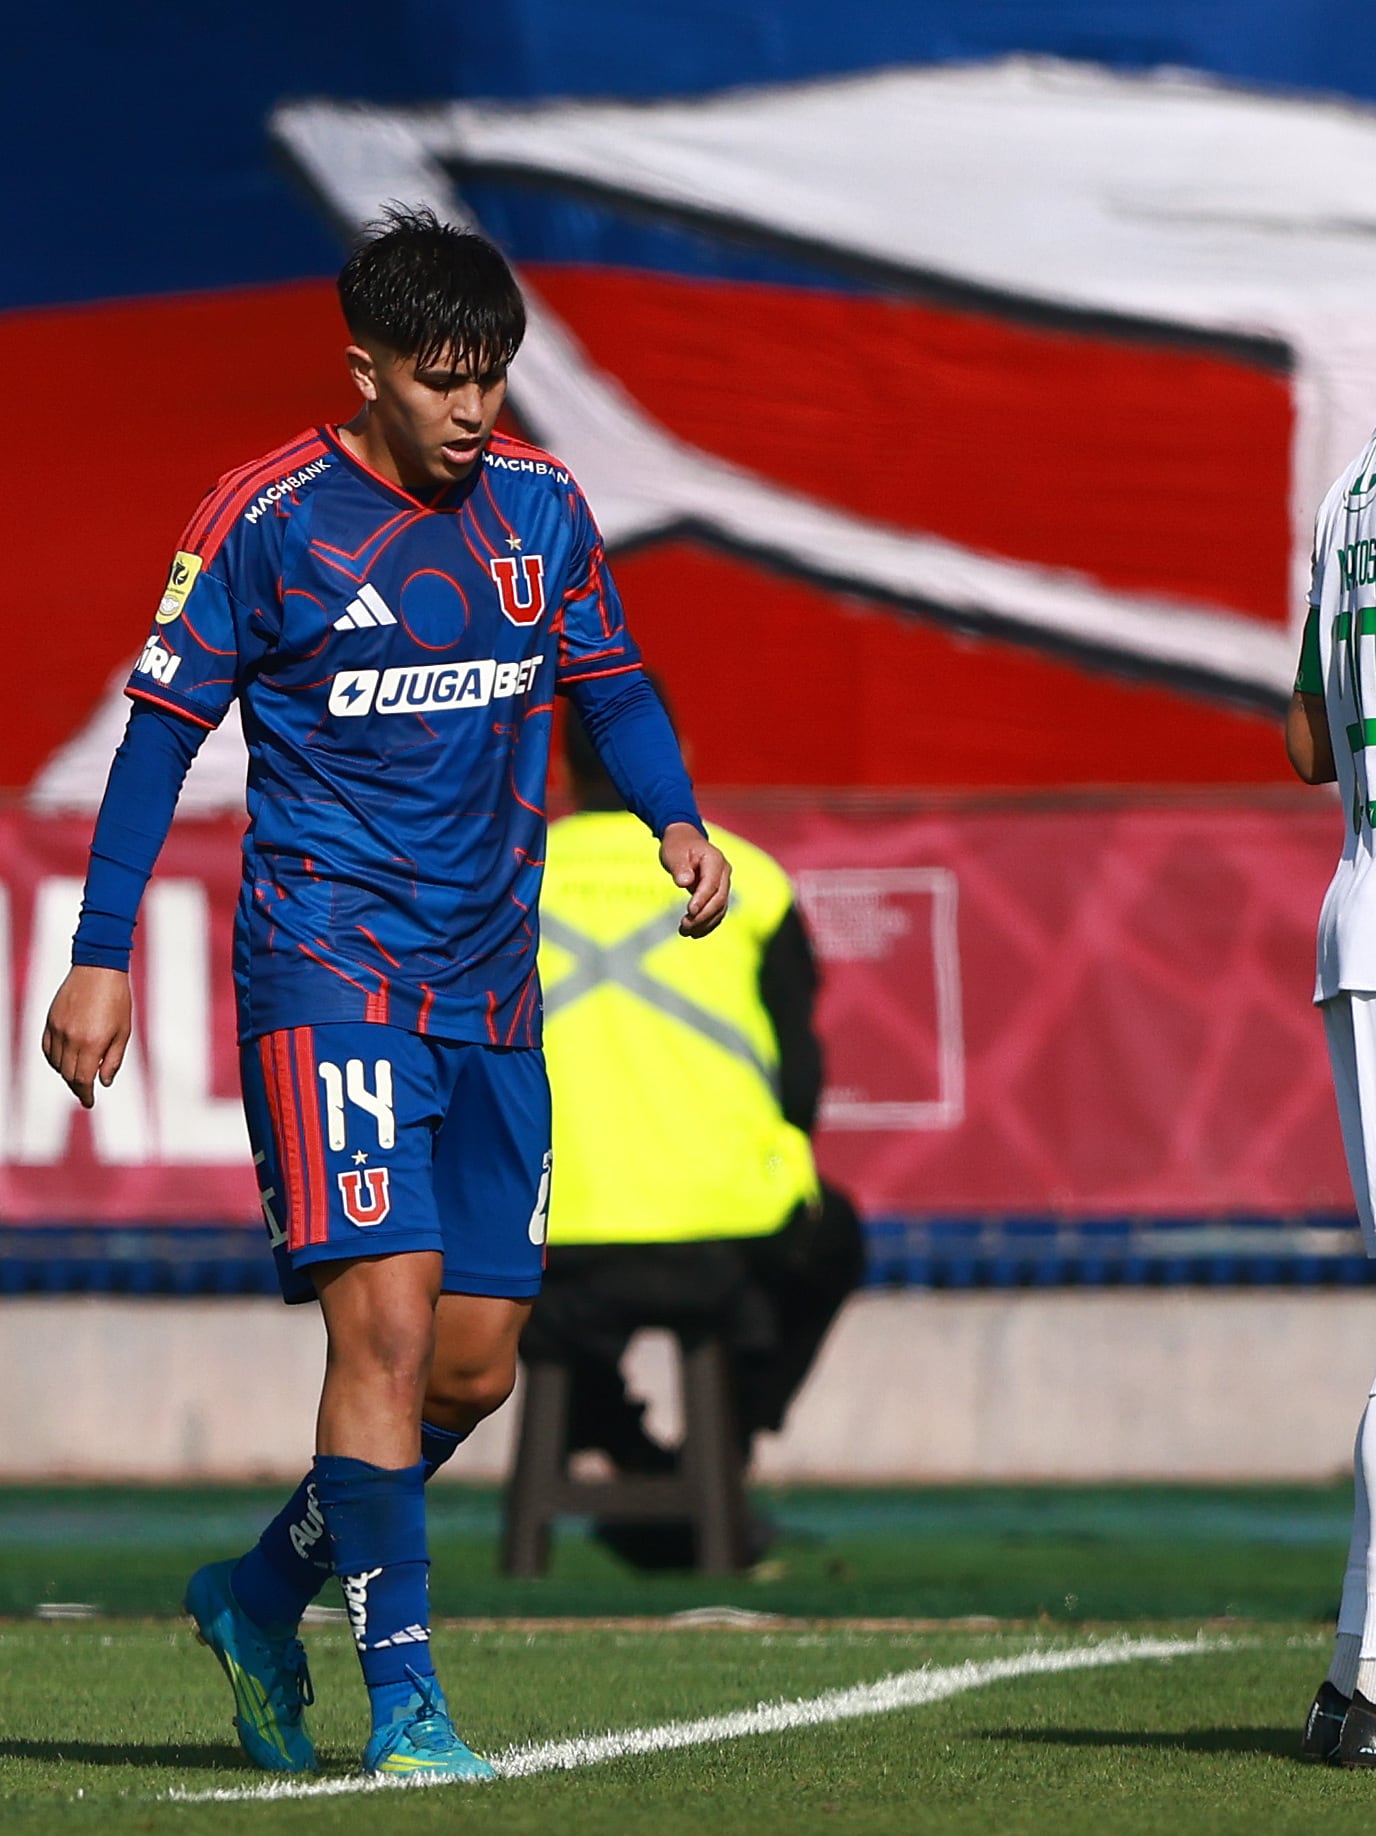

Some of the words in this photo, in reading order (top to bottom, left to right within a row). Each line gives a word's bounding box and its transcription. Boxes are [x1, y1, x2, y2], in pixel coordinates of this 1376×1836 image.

[244, 458, 332, 524] MACHBANK
[490, 554, 545, 627] U
[381, 655, 544, 708] JUGABET
[0, 873, 253, 1166] AL
[318, 1058, 395, 1152] 14
[337, 1167, 390, 1227] U
